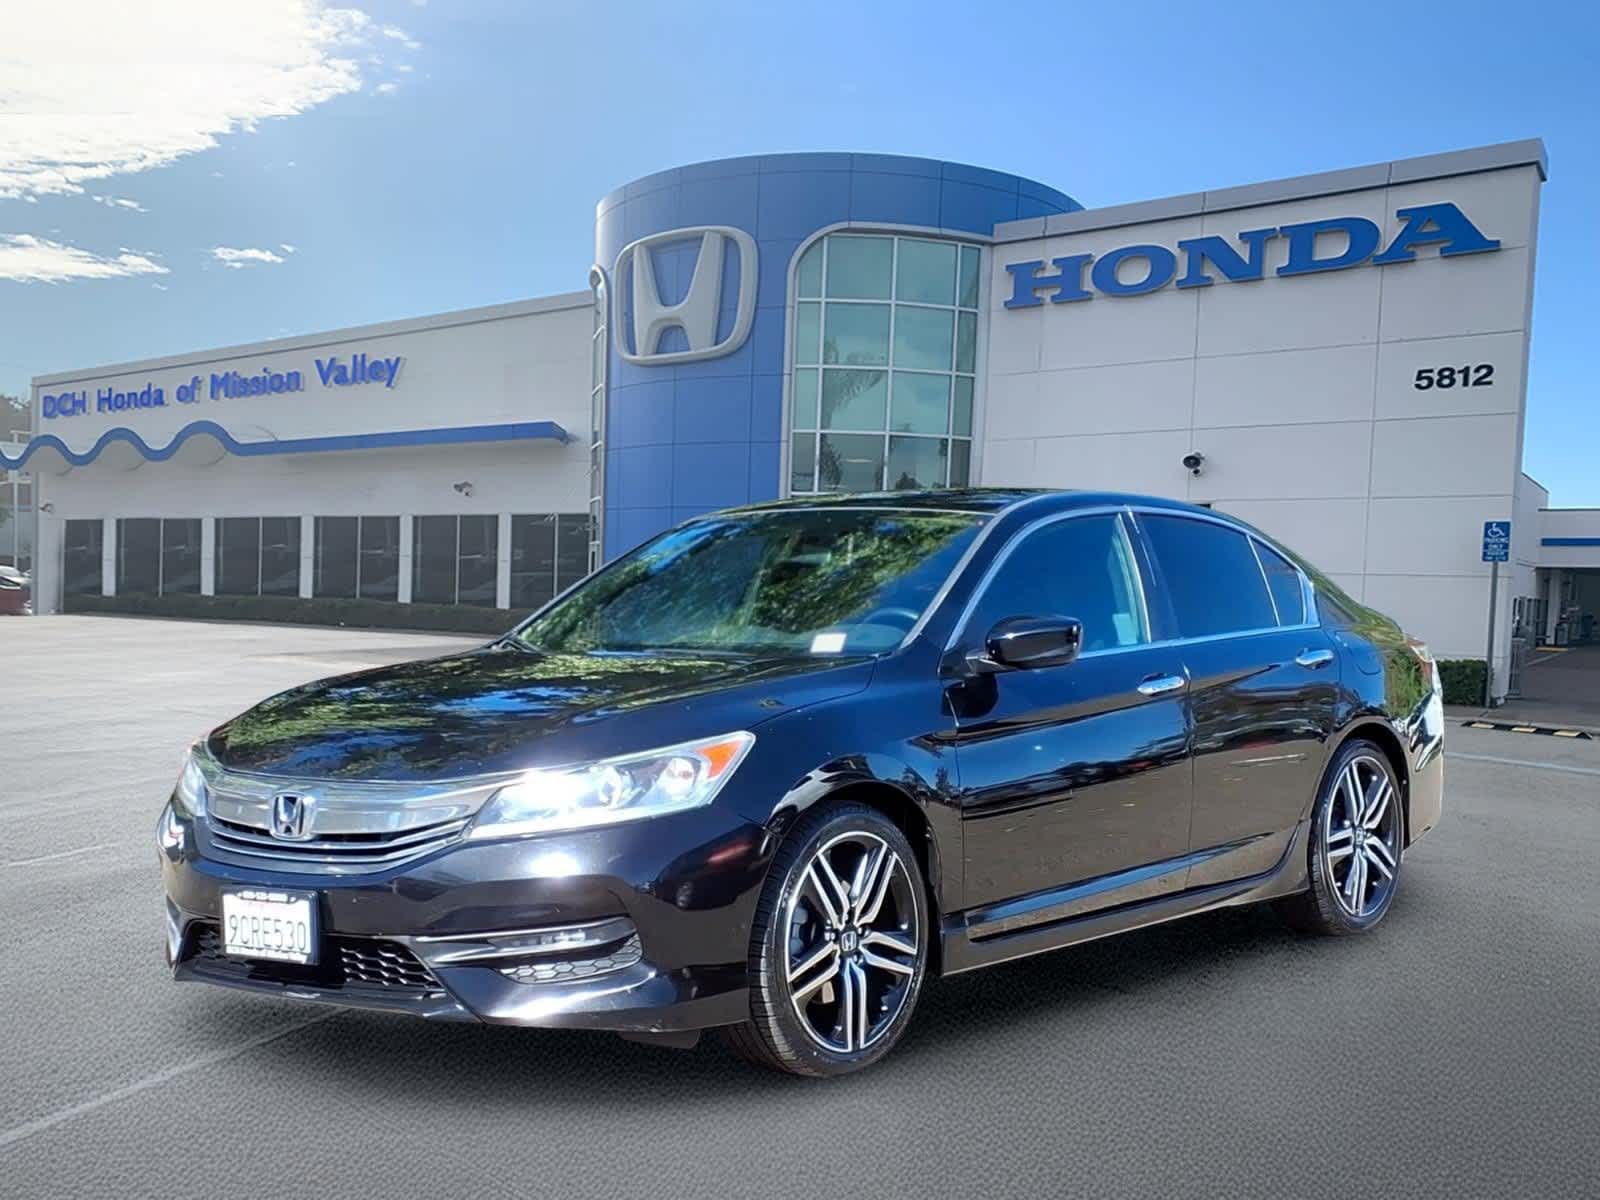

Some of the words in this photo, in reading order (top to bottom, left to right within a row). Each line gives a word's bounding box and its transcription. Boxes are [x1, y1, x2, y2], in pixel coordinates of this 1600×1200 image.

[1004, 202, 1500, 309] HONDA
[42, 391, 87, 418] DCH
[96, 382, 165, 412] Honda
[176, 376, 203, 402] of
[209, 367, 302, 399] Mission
[315, 353, 401, 388] Valley
[1413, 364, 1495, 391] 5812
[228, 914, 307, 952] 9CRE530
